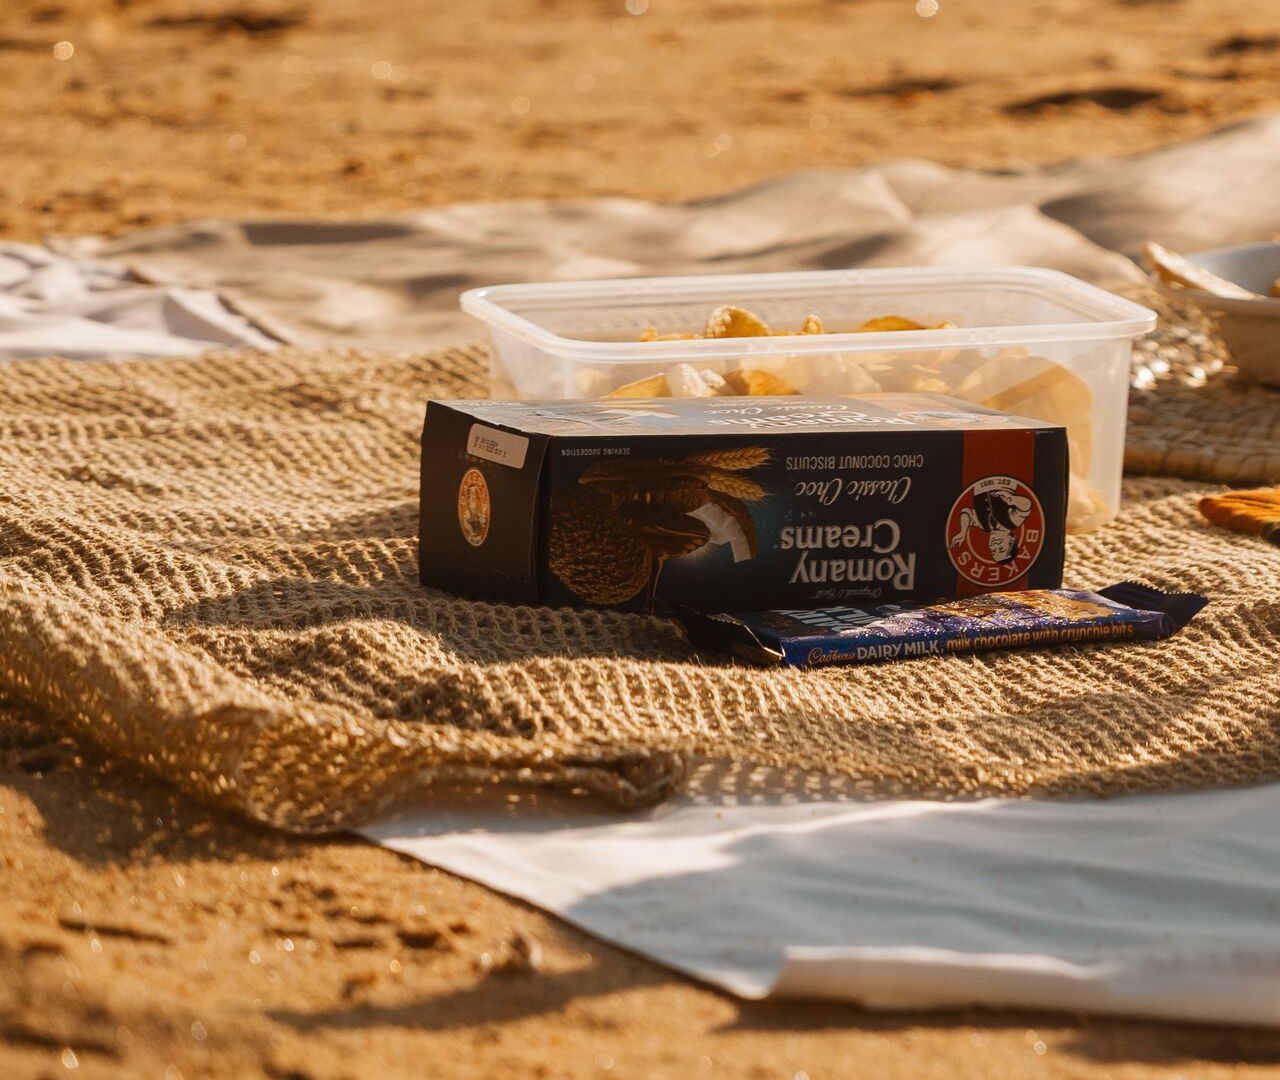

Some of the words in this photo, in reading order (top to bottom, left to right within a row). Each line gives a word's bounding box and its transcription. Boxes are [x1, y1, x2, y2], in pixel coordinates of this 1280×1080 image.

[561, 448, 602, 456] SUGGESTION
[785, 455, 836, 470] BISCUITS
[838, 455, 891, 469] COCONUT
[893, 454, 924, 468] CHOC
[795, 477, 844, 505] Choc
[846, 476, 912, 504] Classic
[779, 519, 901, 554] Creams
[956, 528, 1040, 582] BAKERS
[788, 550, 917, 590] Romany
[808, 647, 856, 665] Cadbury
[856, 643, 902, 660] DAIRY
[946, 634, 970, 649] milk
[973, 630, 1031, 648] chocolate
[1032, 626, 1058, 643] with
[1060, 623, 1110, 641] crunchie
[1111, 621, 1134, 637] bits
